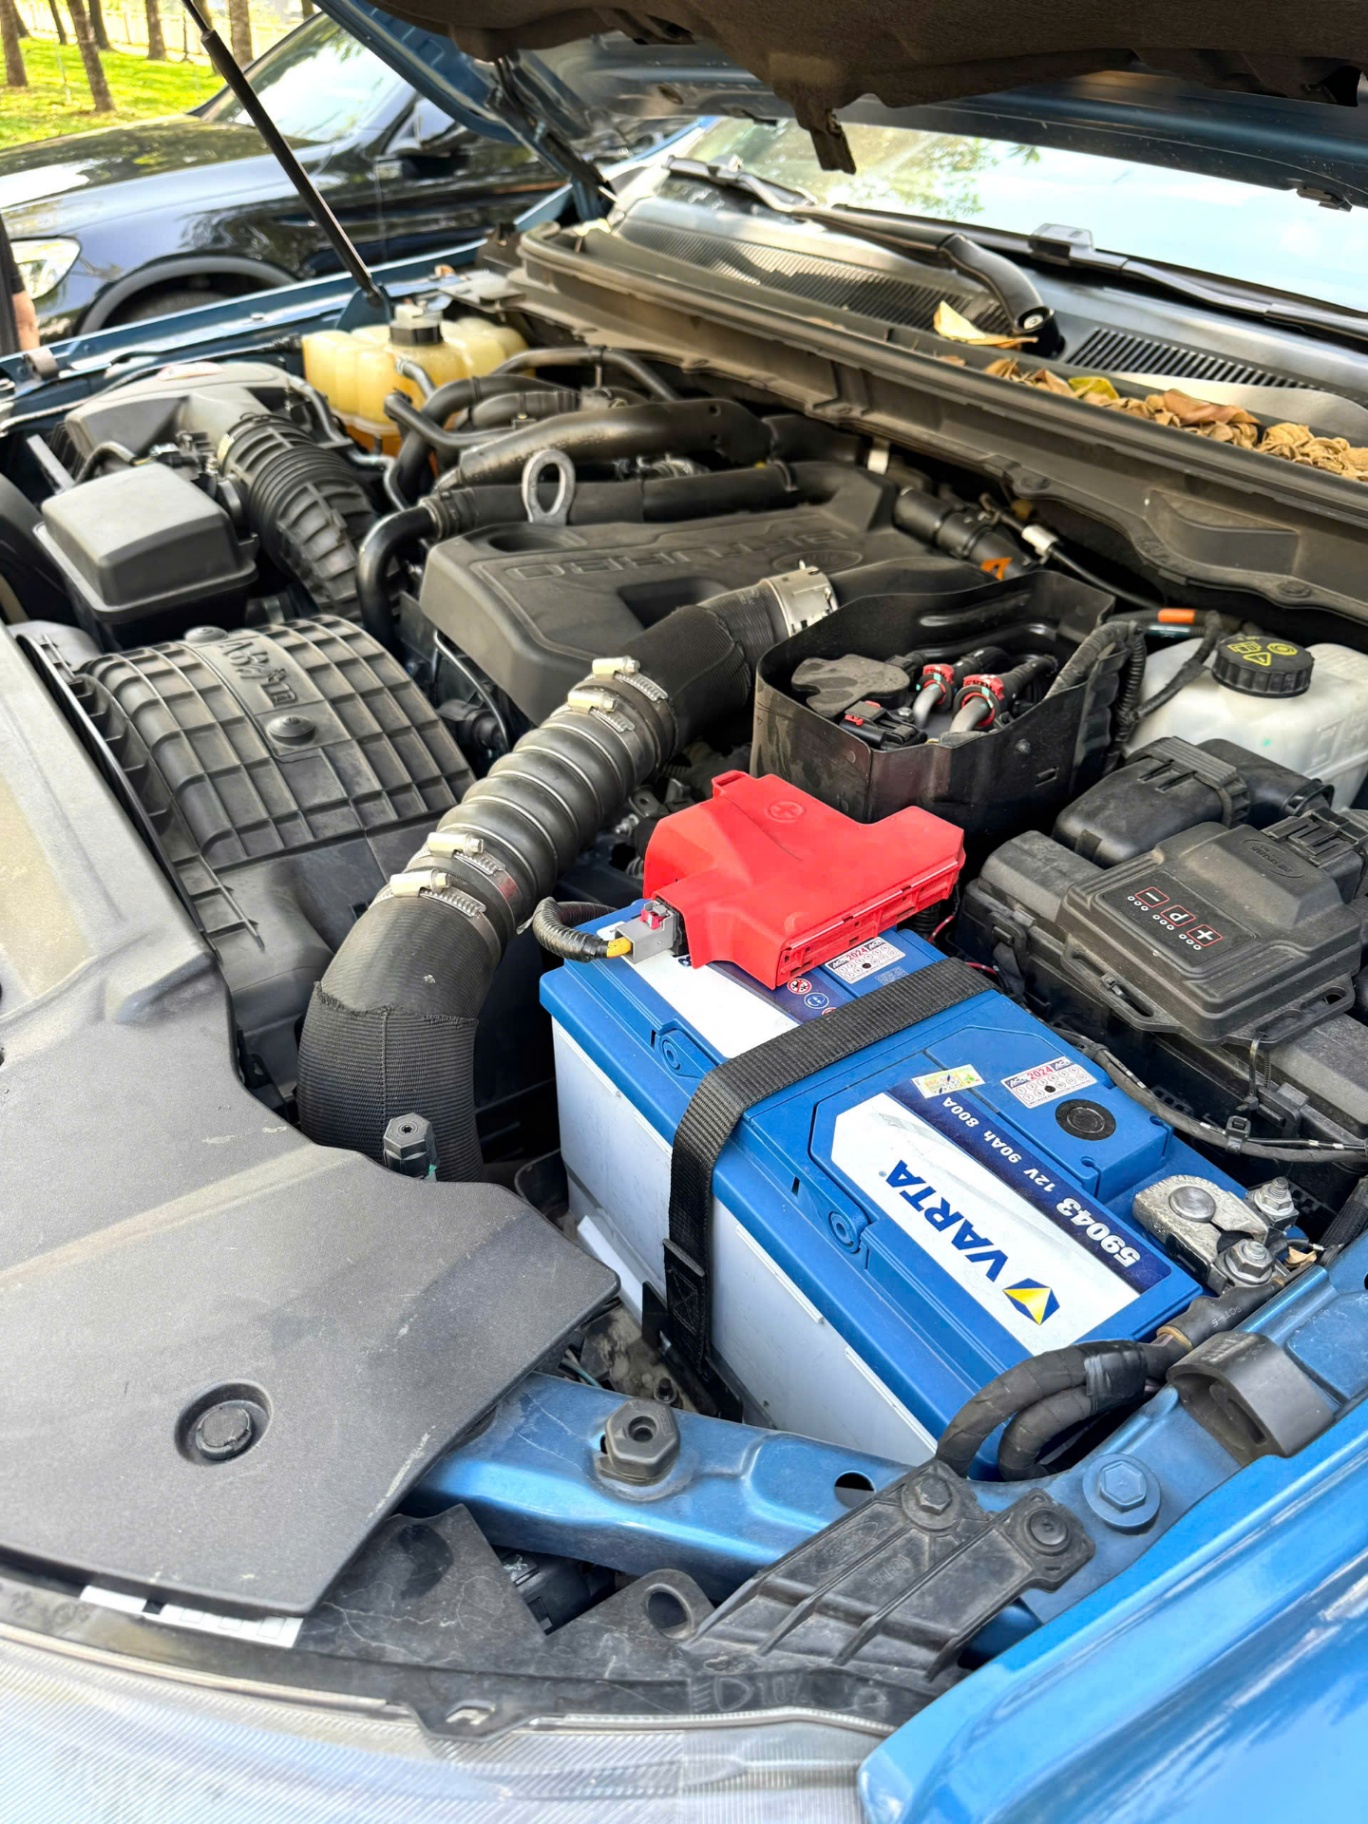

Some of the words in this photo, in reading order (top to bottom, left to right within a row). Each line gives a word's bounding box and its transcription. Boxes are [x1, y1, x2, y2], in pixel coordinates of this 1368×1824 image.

[846, 947, 868, 960] 2024
[1026, 1065, 1053, 1080] 2024
[942, 1096, 980, 1128] 800A
[983, 1130, 1022, 1163] 90Ah
[1023, 1168, 1056, 1192] 12V
[885, 1159, 1009, 1283] VARTA
[1055, 1198, 1141, 1267] 59043
